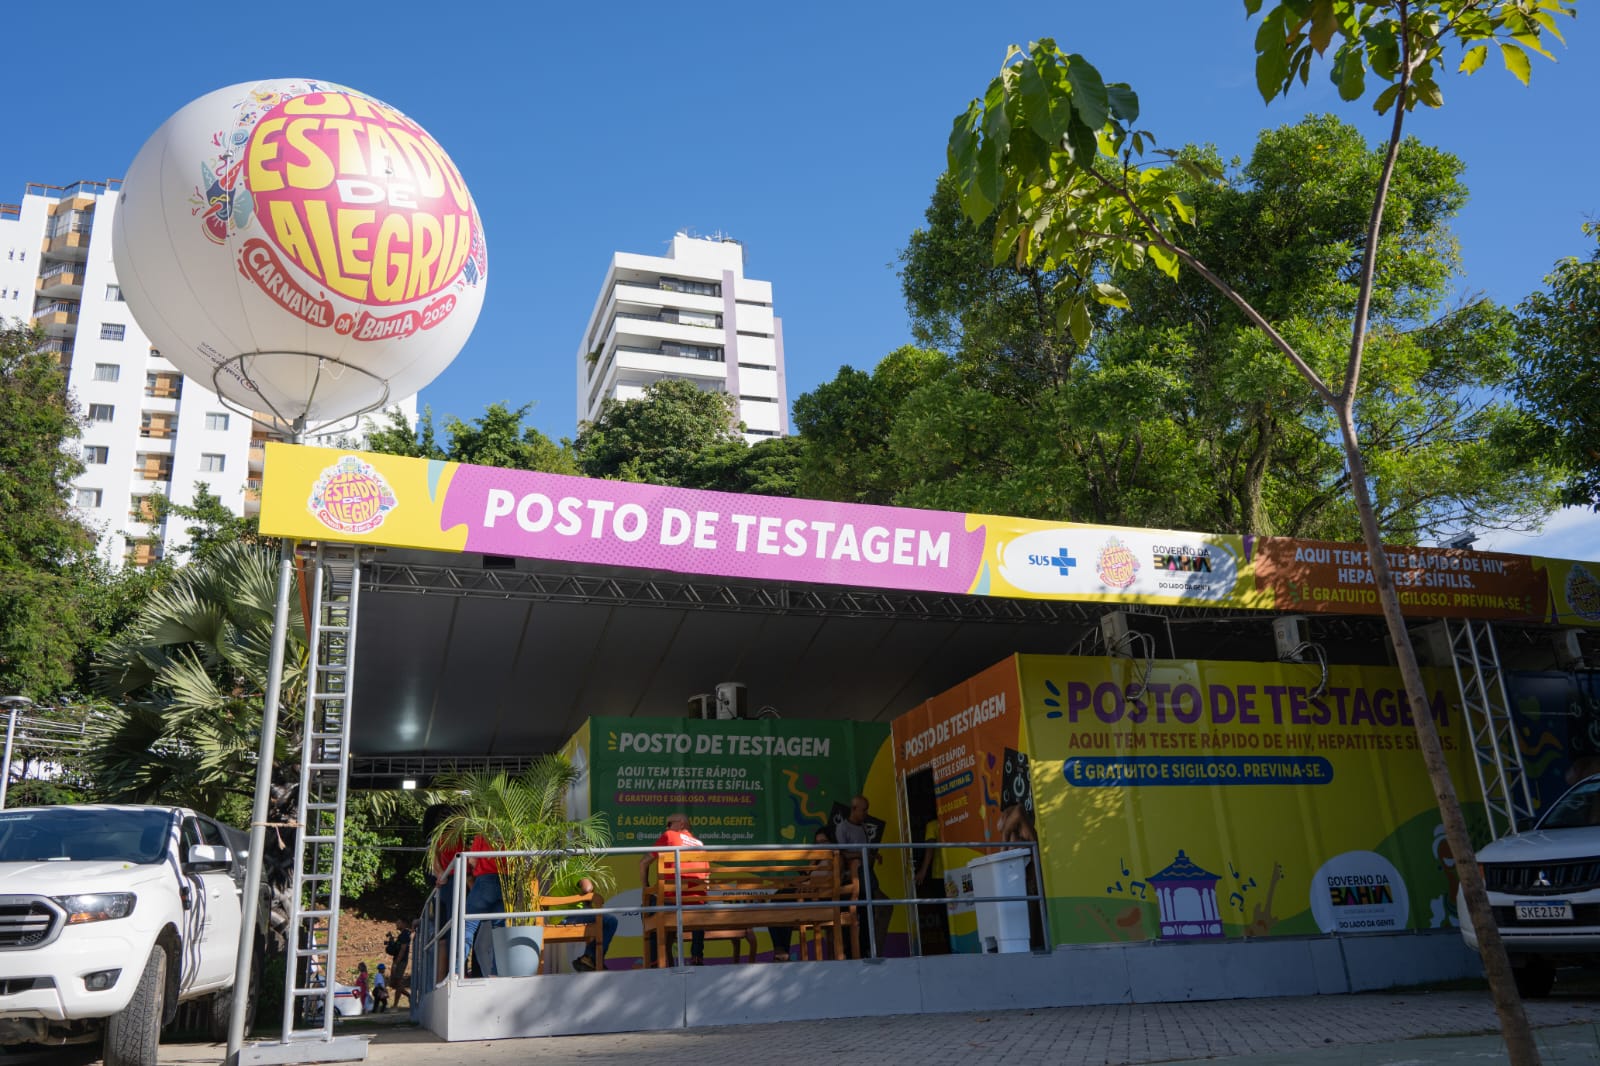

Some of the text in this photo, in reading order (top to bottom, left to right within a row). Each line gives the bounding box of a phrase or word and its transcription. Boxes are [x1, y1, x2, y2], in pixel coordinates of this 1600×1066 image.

[248, 117, 468, 212] ESTADO
[336, 179, 418, 209] DE
[269, 200, 471, 303] ALEGRIA
[250, 247, 454, 340] CARNAVAL DA BAHIA 2026
[325, 480, 379, 501] ESTADO
[483, 488, 951, 568] POSTO DE TESTAGEM
[1028, 554, 1050, 566] SUS
[1152, 545, 1210, 557] GOVERNO DA
[1295, 547, 1330, 564] AQUI
[1333, 550, 1362, 566] TEM
[1409, 552, 1460, 571] RÁPIDO
[1462, 557, 1481, 572] DE
[1483, 559, 1507, 576] HIV,
[1153, 554, 1212, 573] BAHIA
[1414, 573, 1422, 586] E
[1426, 569, 1476, 588] SÍFILIS.
[1313, 588, 1376, 604] GRATUITO
[1454, 594, 1524, 611] PREVINA-SE.
[1067, 682, 1450, 727] POSTO DE TESTAGEM
[905, 692, 1006, 760] POSTO DE TESTAGEM
[619, 733, 830, 757] POSTO DE TESTAGEM
[1069, 732, 1110, 749] AQUI
[1114, 733, 1146, 749] TEM
[1150, 733, 1198, 749] TESTE
[1201, 728, 1260, 749] RÁPIDO
[1263, 733, 1282, 749] DE
[1286, 733, 1315, 752] HIV,
[1318, 734, 1393, 750] HEPATITES
[1395, 735, 1403, 750] E
[617, 765, 747, 778] AQUI TEM TESTE RÁPIDO
[1073, 760, 1325, 780] É GRATUITO E SIGILOSO. PREVINA-SE.
[617, 778, 764, 791] DE HIV, HEPATITES E SÍFILIS.
[625, 794, 662, 803] GRATUITO
[624, 816, 631, 826] A
[633, 813, 665, 826] SAÚDE
[709, 816, 721, 826] DA
[1328, 874, 1389, 886] GOVERNO DA
[1329, 885, 1393, 906] BAHIA
[1349, 920, 1366, 928] LADO
